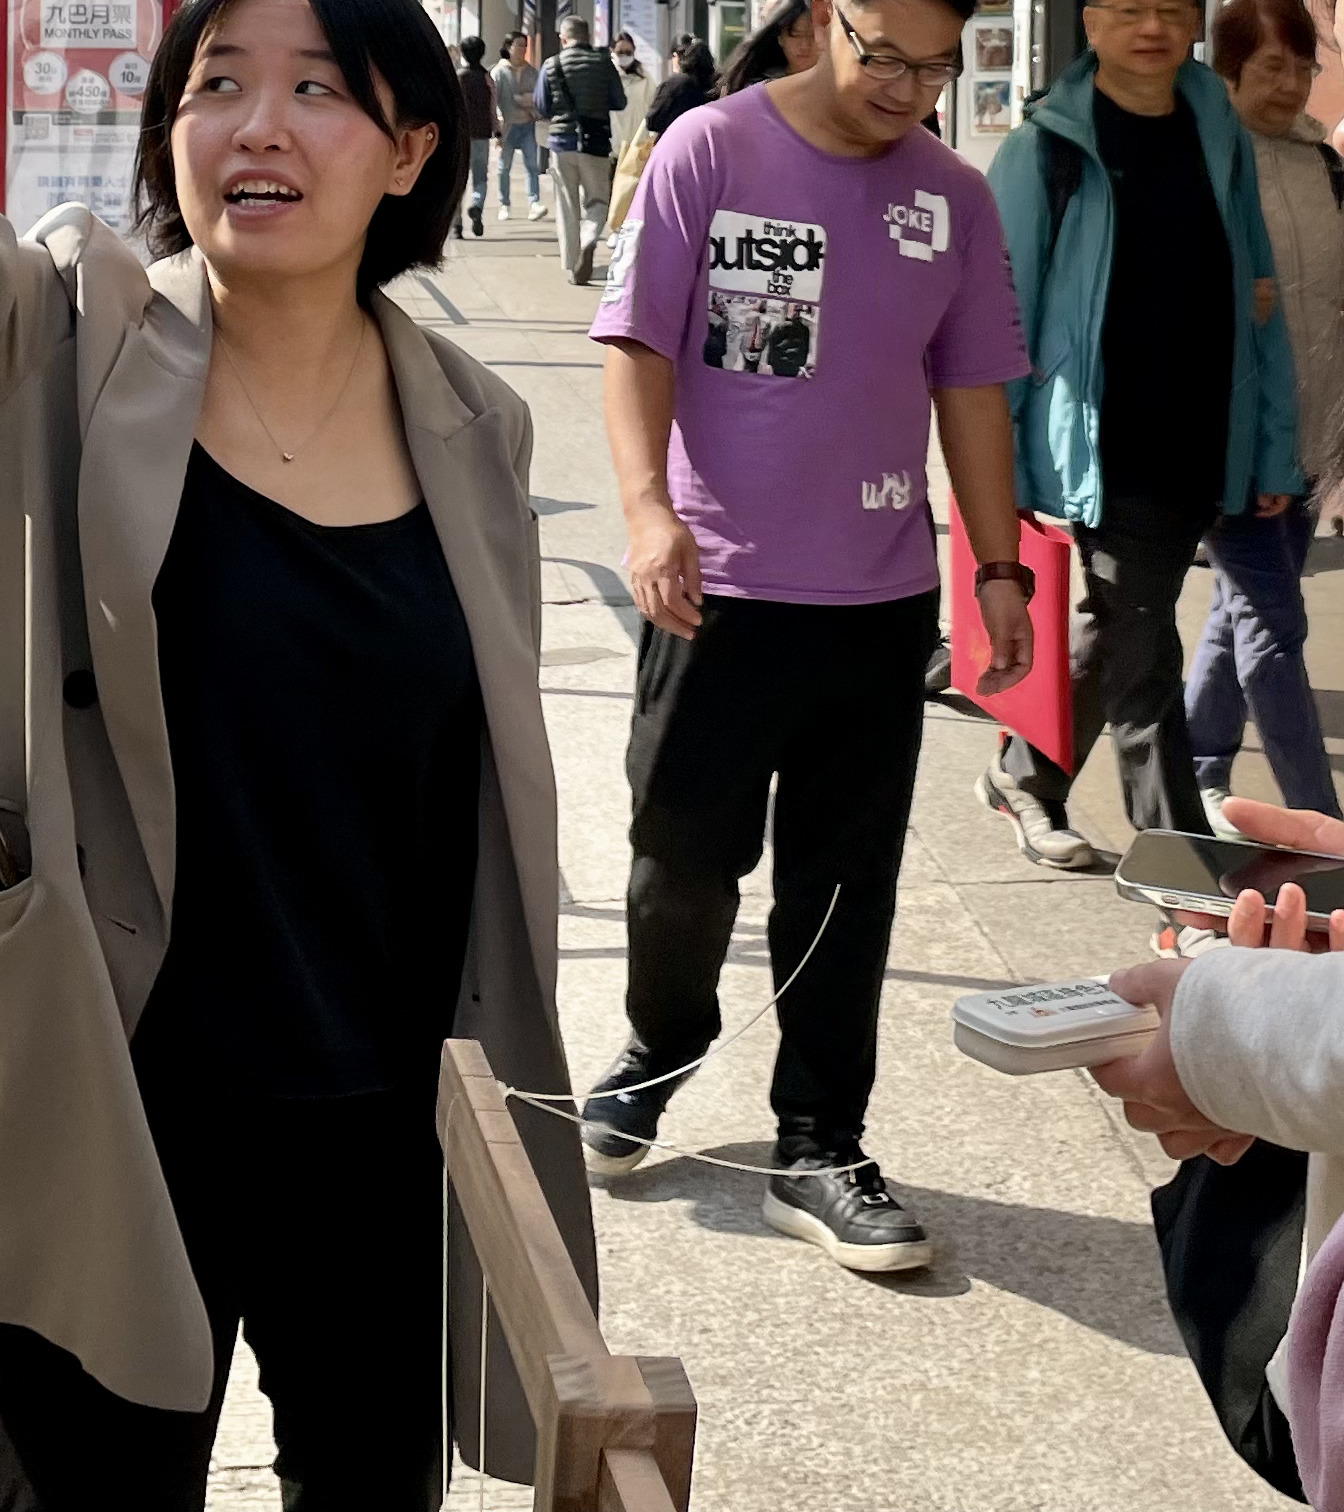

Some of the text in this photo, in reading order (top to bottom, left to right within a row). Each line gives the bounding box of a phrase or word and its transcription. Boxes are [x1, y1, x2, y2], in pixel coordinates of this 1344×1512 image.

[45, 3, 133, 26] 九巴月票
[44, 27, 133, 40] MONTHLY PASS
[882, 202, 934, 233] JOKE
[763, 220, 798, 239] think
[772, 268, 794, 284] the
[767, 280, 792, 296] box
